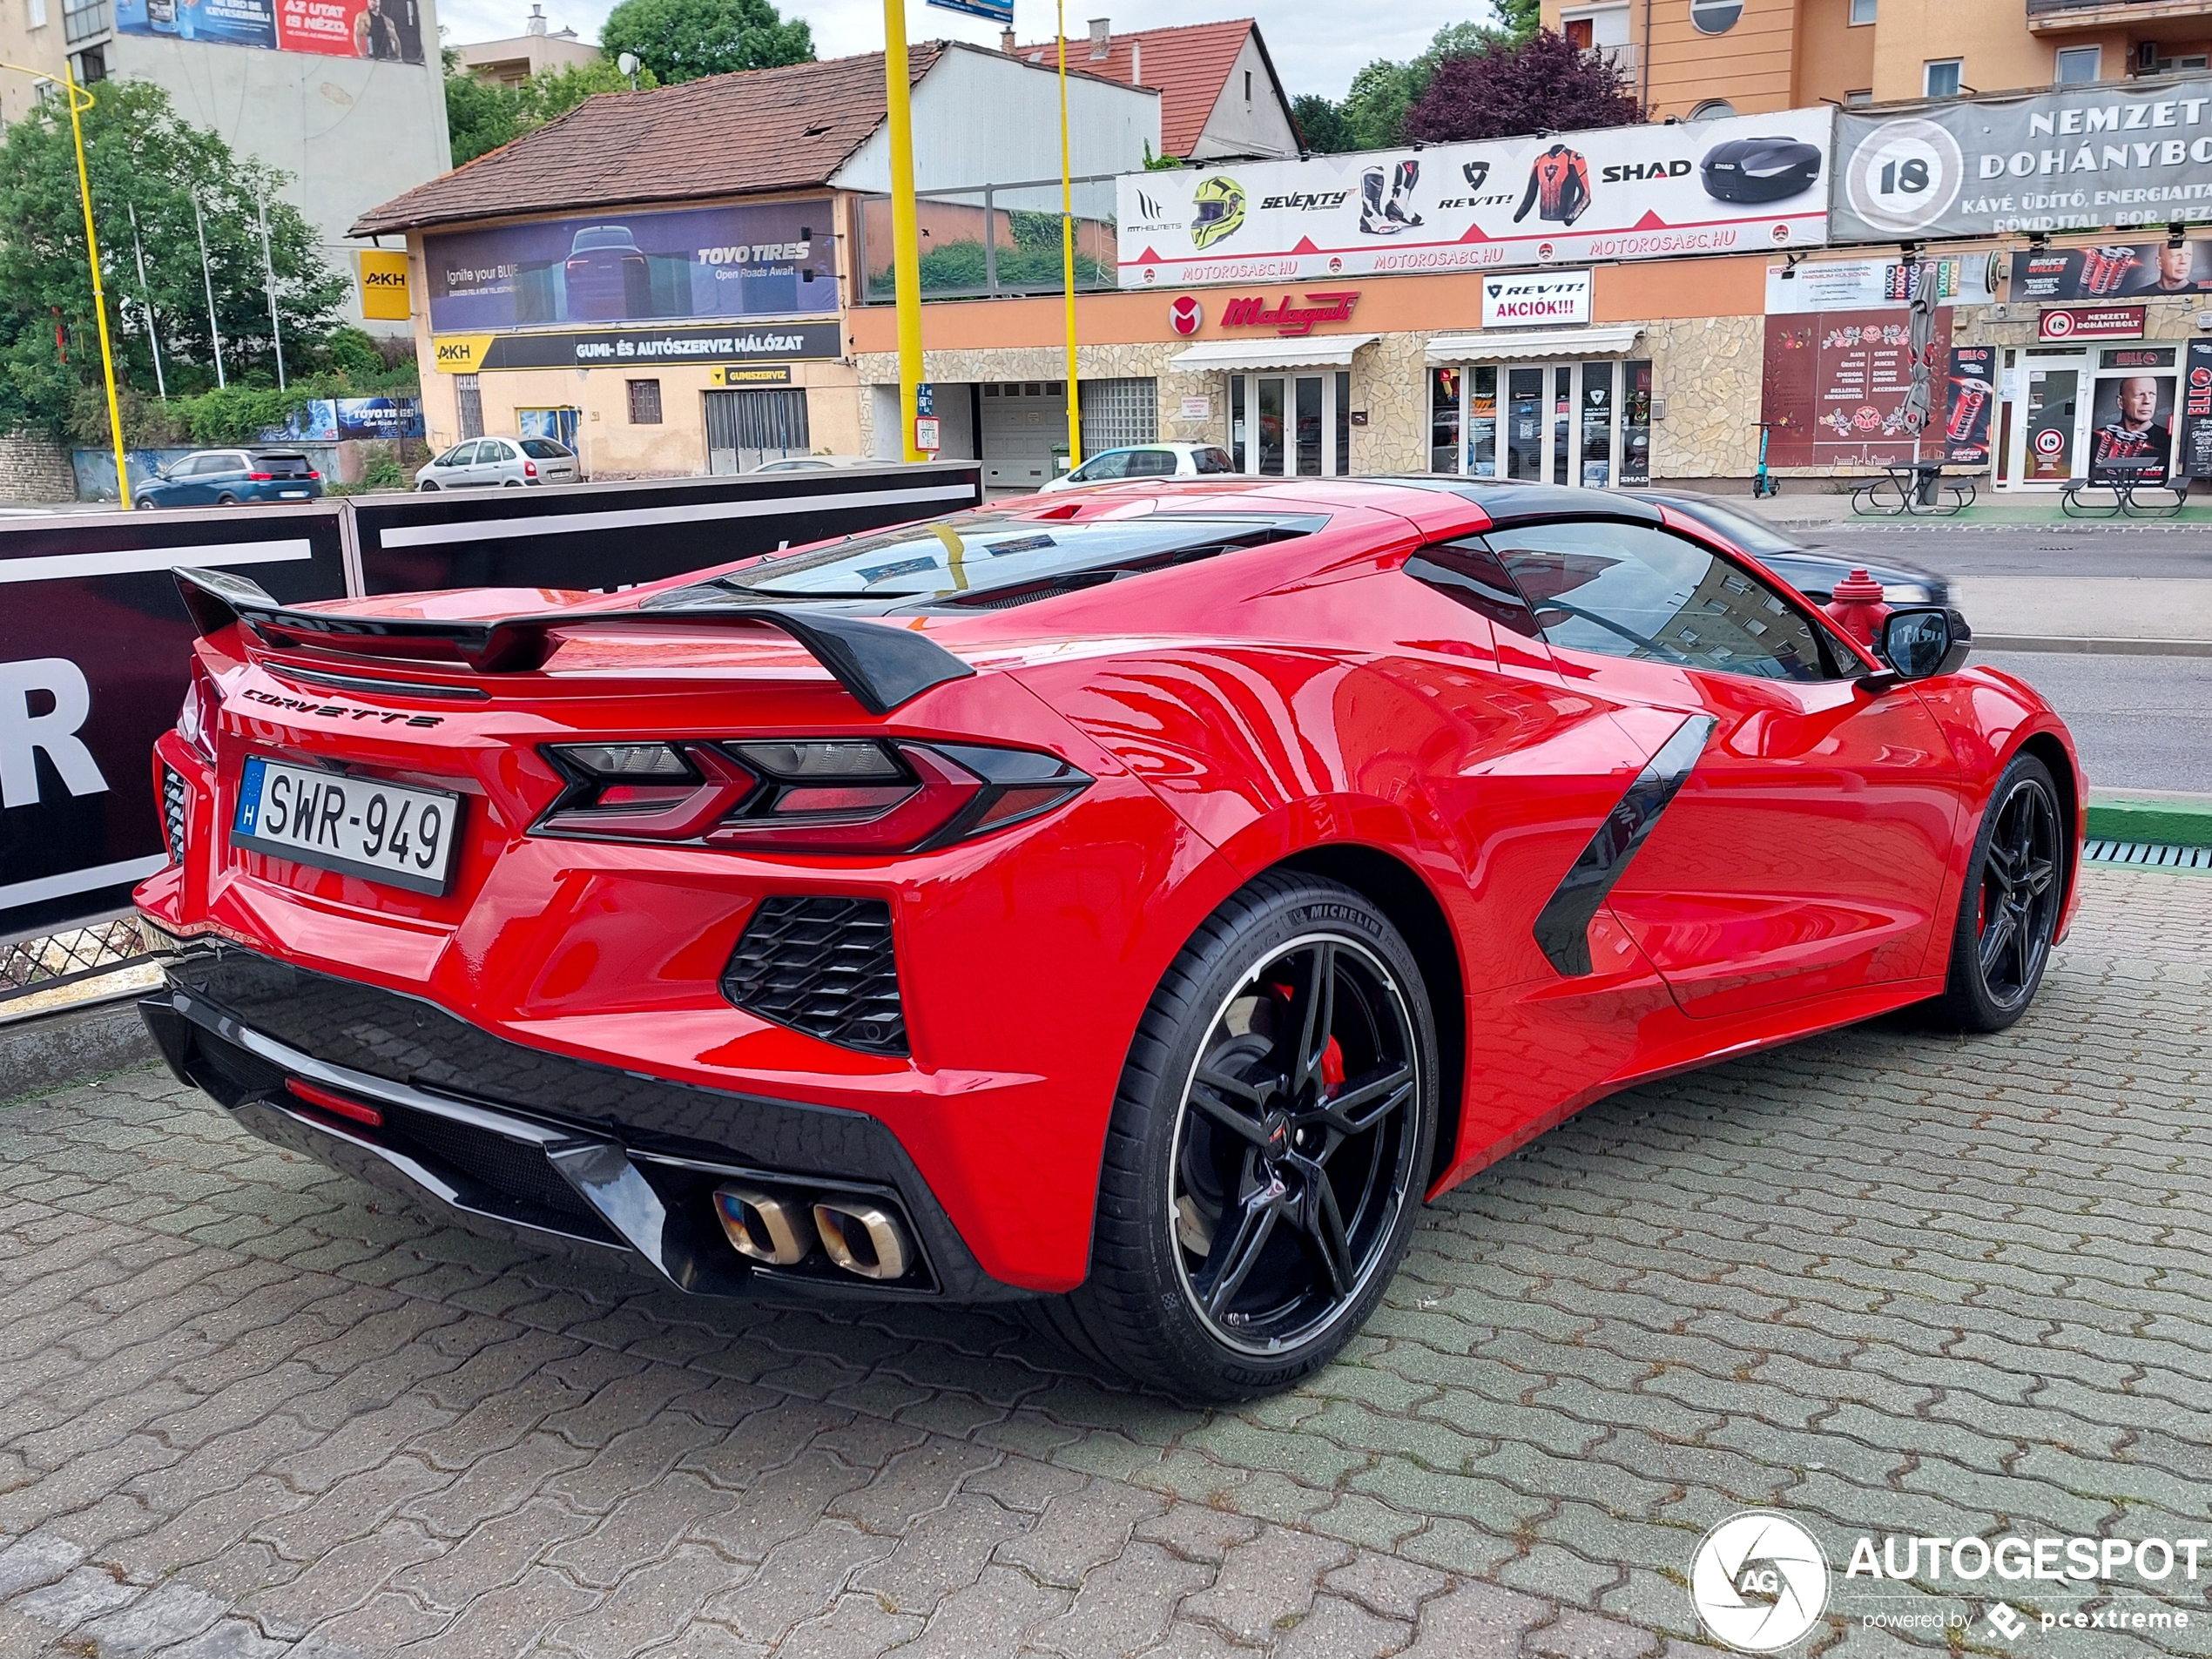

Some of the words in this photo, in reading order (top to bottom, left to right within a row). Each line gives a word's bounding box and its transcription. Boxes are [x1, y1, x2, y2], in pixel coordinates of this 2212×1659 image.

[284, 0, 307, 14] AZ
[308, 2, 346, 18] UTAT
[286, 15, 301, 28] IS
[304, 16, 349, 36] NÉZD,
[2029, 97, 2212, 138] NEMZET
[1602, 159, 1692, 183] SHAD
[1880, 158, 1930, 194] 18
[1260, 191, 1347, 212] SEVENTY
[1437, 194, 1514, 209] REV'IT!
[1961, 193, 2017, 214] KÁVÉ,
[2021, 188, 2089, 211] ÜDÍTŐ,
[2170, 206, 2212, 223] PEZ
[1141, 223, 1182, 232] HELMETS
[698, 246, 749, 265] TOYO
[752, 241, 811, 262] TIRES
[2029, 257, 2068, 266] BRUCE
[447, 266, 474, 286] Ignite
[475, 267, 496, 283] your
[715, 268, 738, 281] Open
[741, 266, 767, 279] Roads
[769, 265, 794, 277] Await
[2028, 265, 2065, 273] WILLIS
[365, 273, 406, 286] AKH
[1506, 283, 1585, 296] REV'IT!
[1220, 291, 1361, 336] Malaguti
[1496, 297, 1574, 317] AKCIÓK!!!
[2053, 320, 2065, 329] 18
[2077, 320, 2140, 329] DOHÁNYBOLT
[437, 345, 471, 360] AKH
[577, 342, 615, 358] GUMI-
[617, 339, 635, 357] ÉS
[637, 337, 733, 355] AUTÓSZERVIZ
[736, 334, 804, 353] HÁLÓZAT
[1958, 349, 1978, 360] HELL
[2116, 352, 2142, 364] HELL
[730, 370, 787, 381] GUMISZERVIZ
[354, 408, 383, 419] TOYO
[2045, 438, 2055, 447] 18
[242, 689, 444, 728] CORVETTE
[243, 805, 255, 826] H
[266, 775, 442, 869] SWR-949
[1310, 905, 1379, 934] MICHELIN
